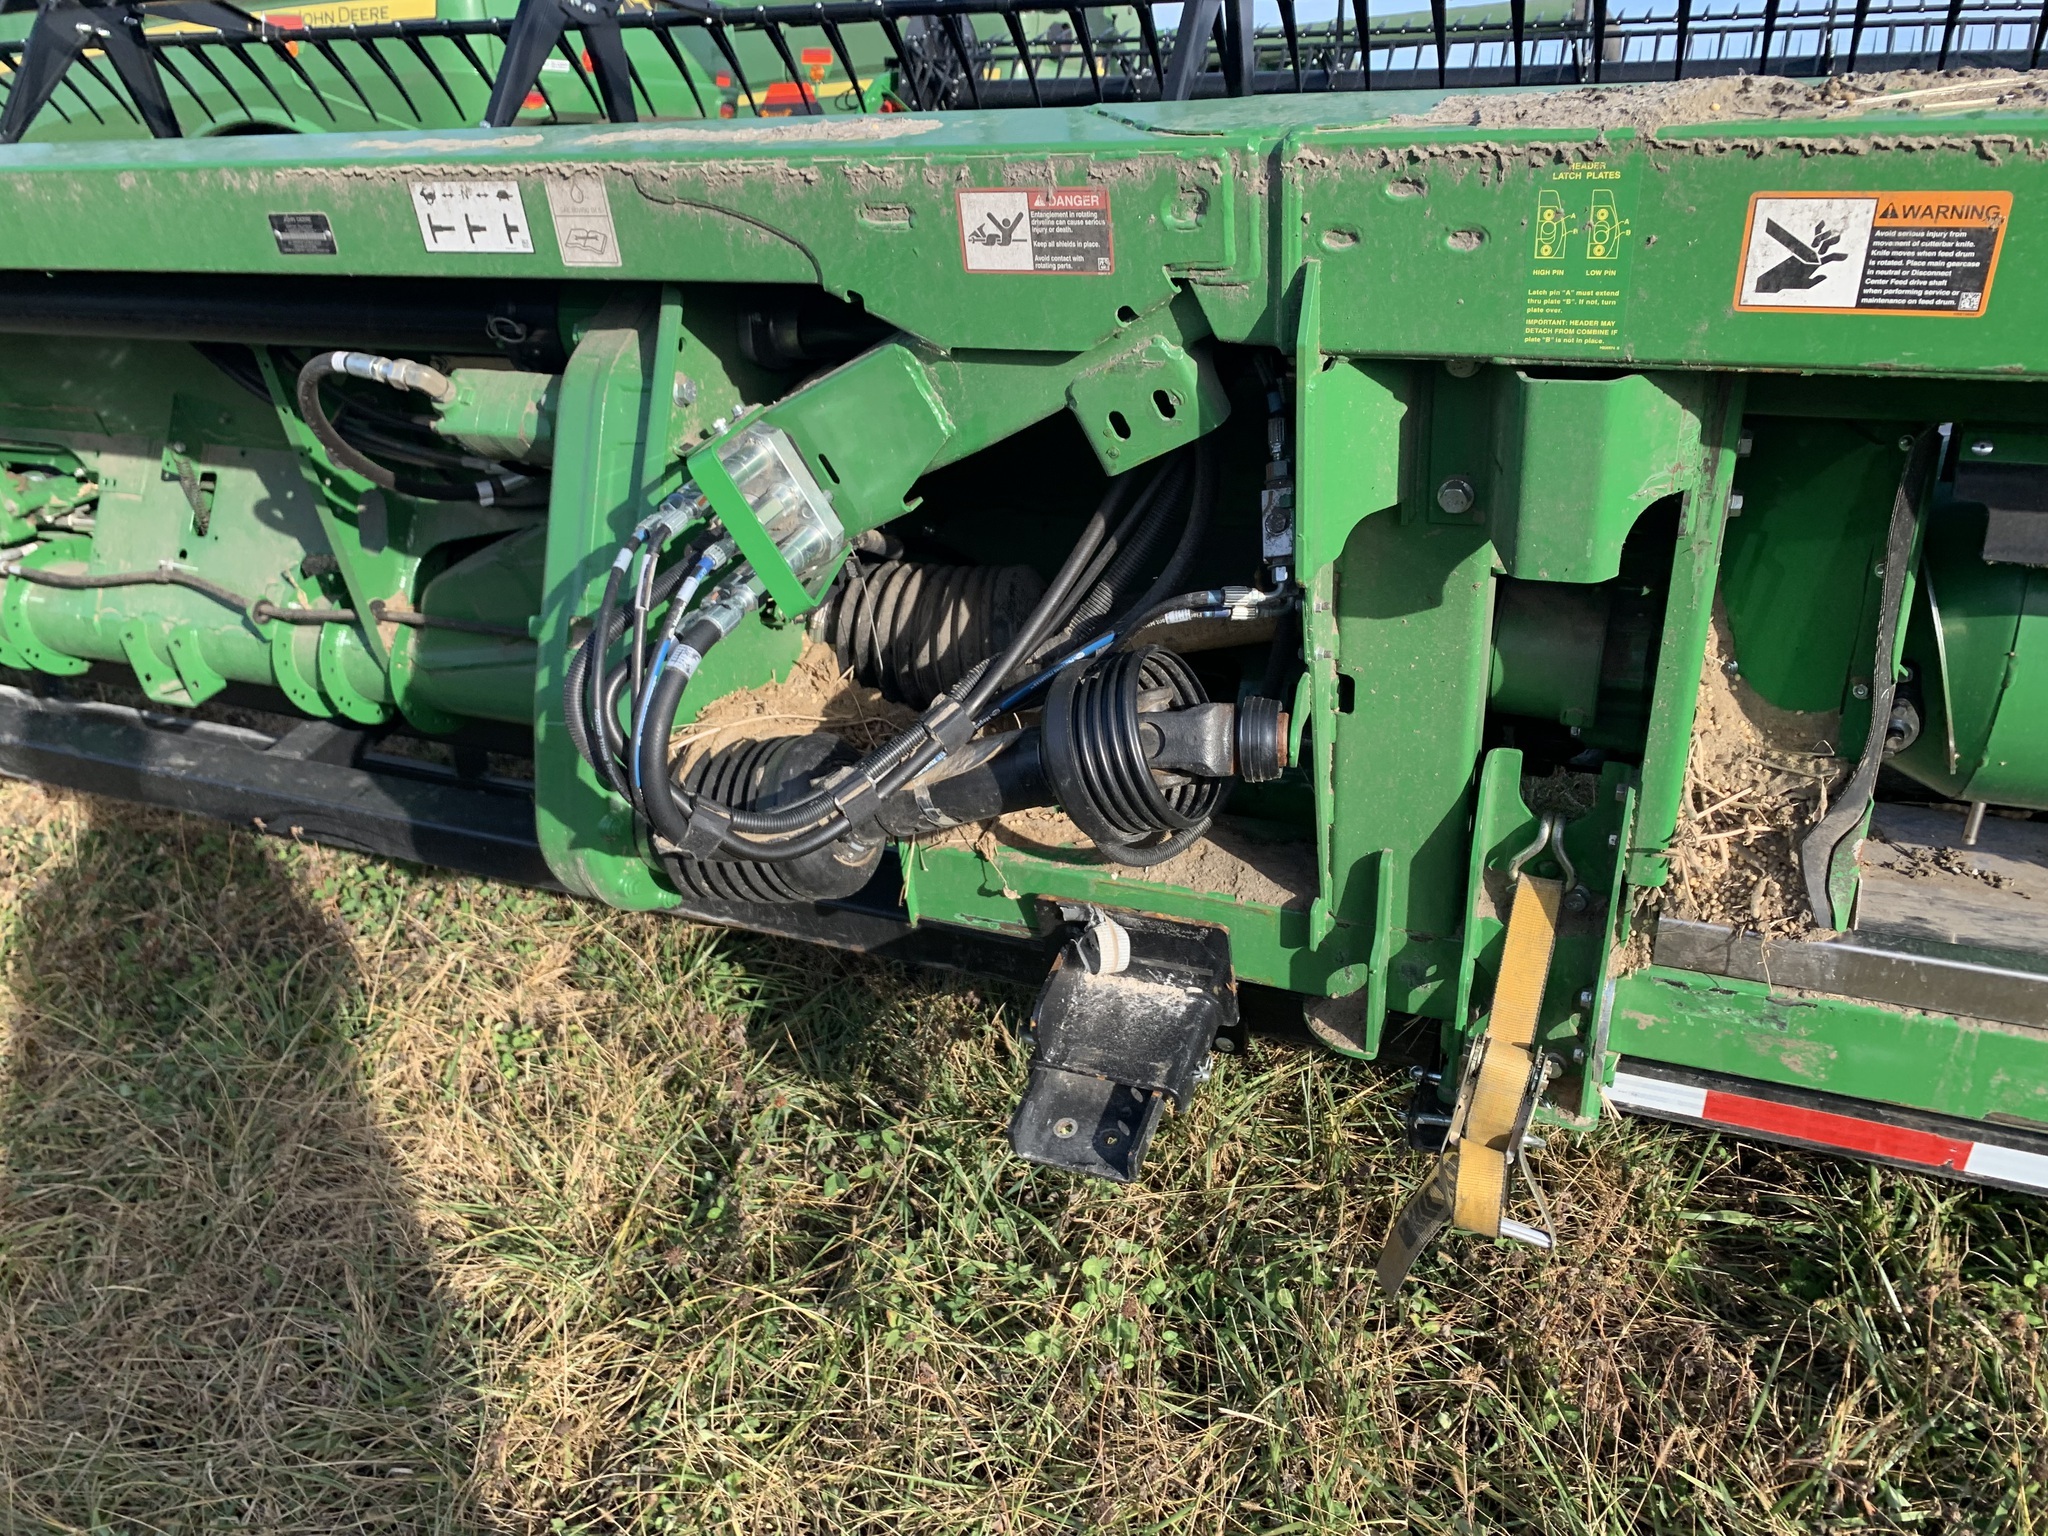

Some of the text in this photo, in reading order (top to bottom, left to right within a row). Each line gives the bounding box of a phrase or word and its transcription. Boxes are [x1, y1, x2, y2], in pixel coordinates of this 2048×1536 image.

[338, 6, 389, 22] DEERE
[1569, 162, 1606, 170] HEADER
[1552, 171, 1621, 180] LATCH PLATES
[1048, 194, 1099, 207] DANGER
[1030, 211, 1068, 219] Entanglement
[1076, 211, 1098, 219] rotating
[1902, 205, 2001, 220] WARNING
[1926, 230, 1948, 239] injury
[1083, 241, 1100, 249] place.
[1955, 240, 1976, 248] knife.
[1909, 278, 1928, 286] drive
[1549, 289, 1560, 297] pin
[1883, 288, 1923, 296] performing
[1584, 337, 1605, 345] place.
